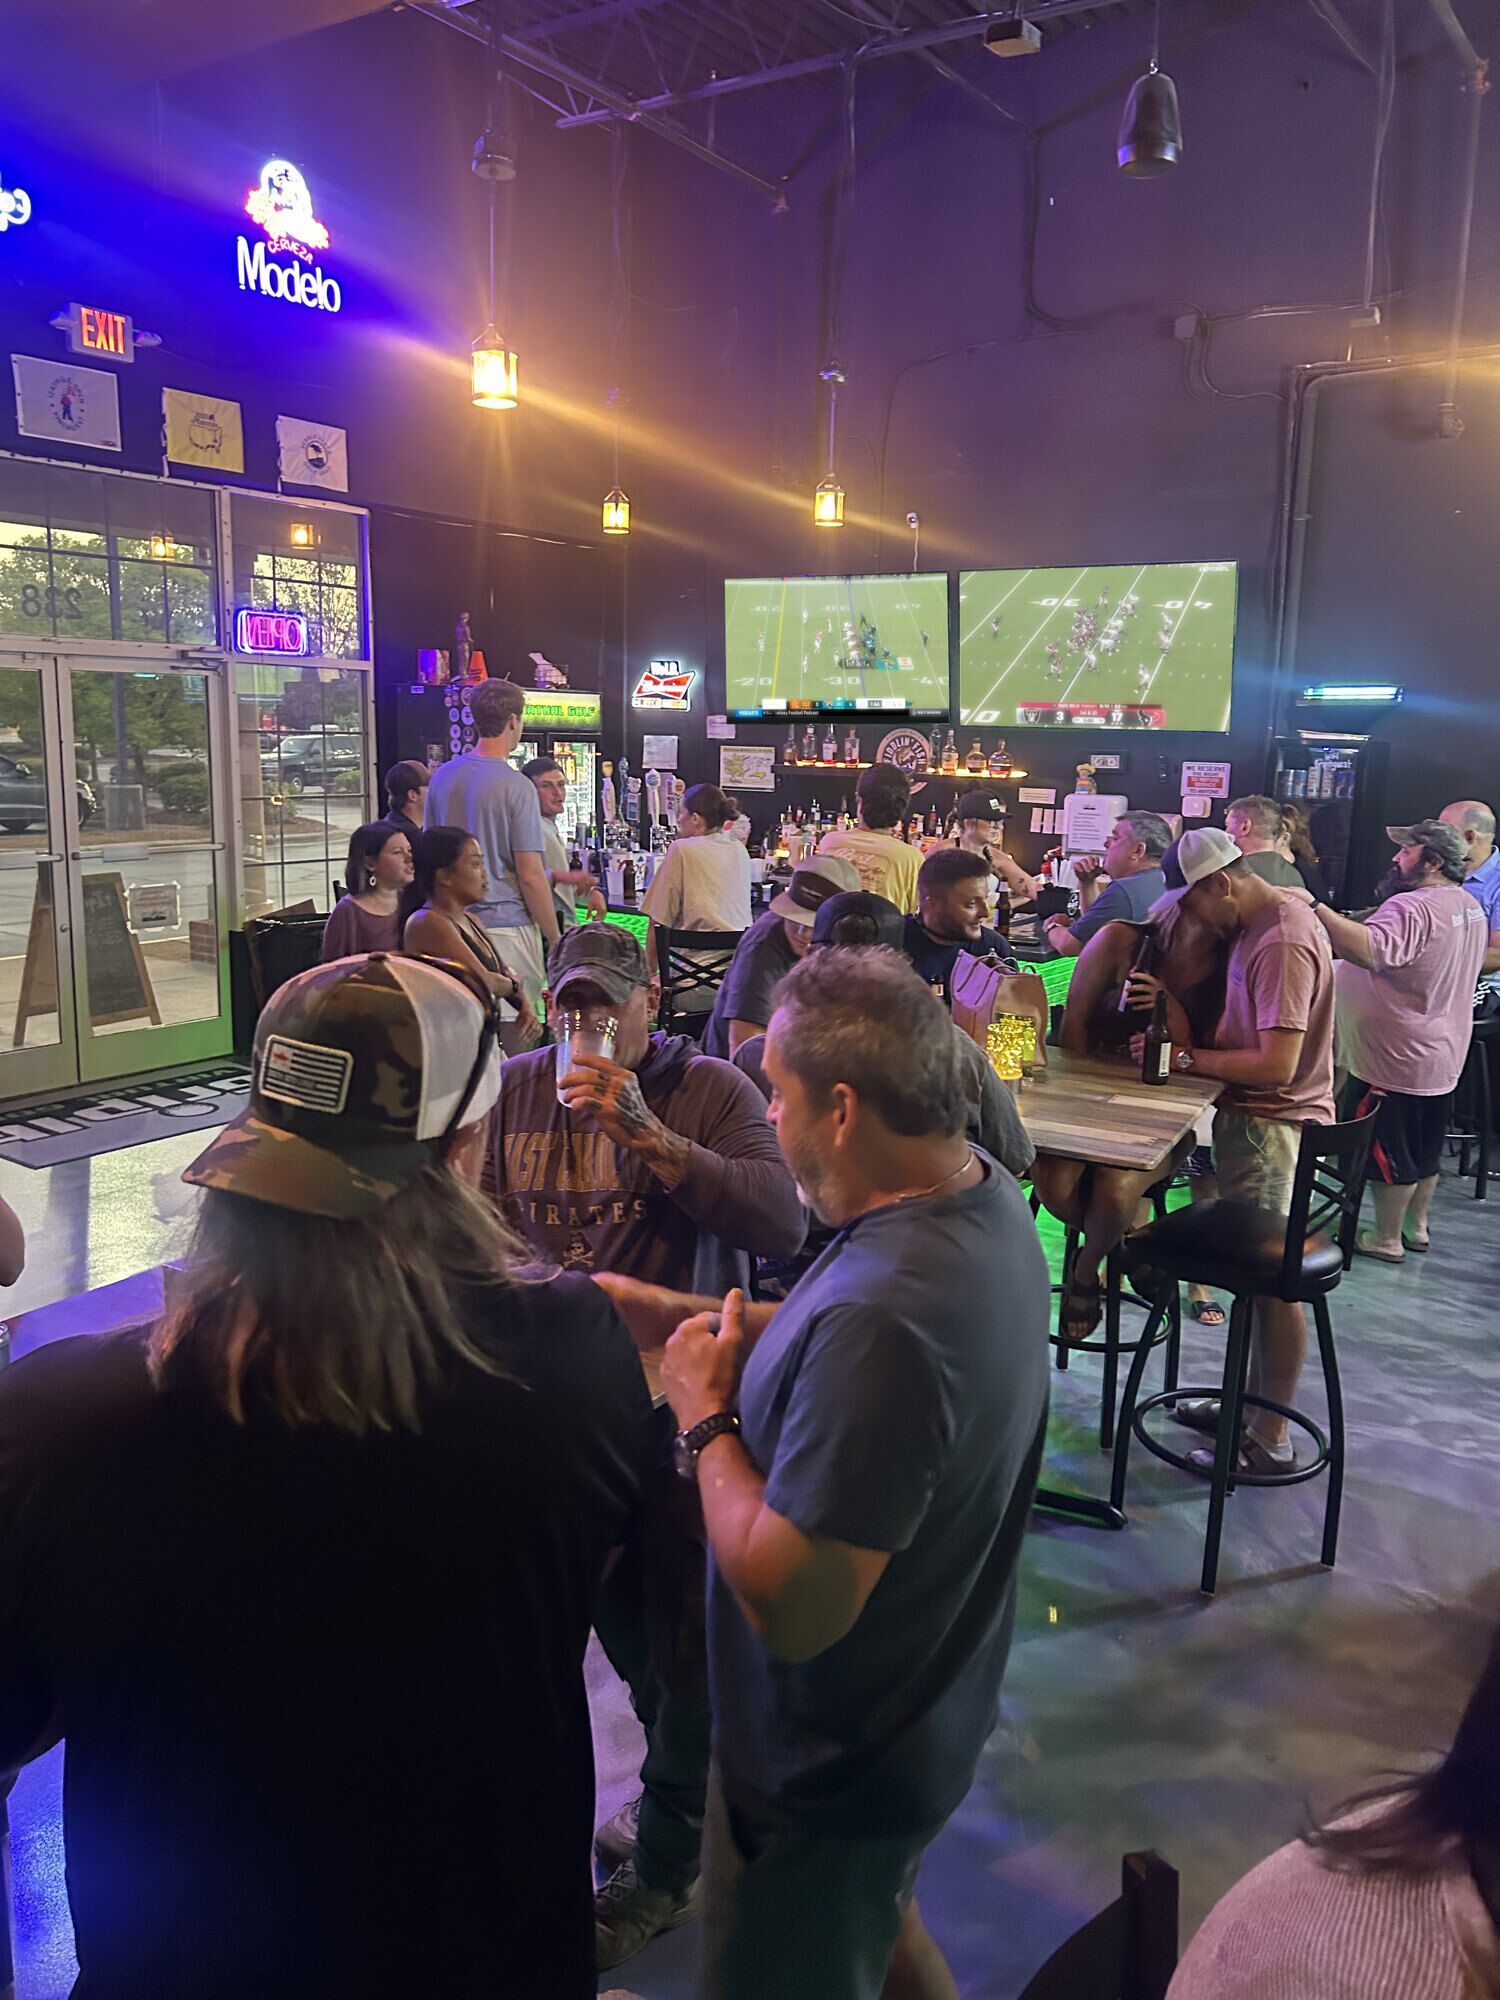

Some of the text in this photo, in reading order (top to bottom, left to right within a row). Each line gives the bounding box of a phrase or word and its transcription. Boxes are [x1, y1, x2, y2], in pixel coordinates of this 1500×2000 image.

[267, 238, 313, 265] CERVEZA
[237, 235, 341, 313] Modelo
[80, 307, 126, 354] EXIT
[741, 677, 773, 686] 20
[829, 676, 861, 685] 30
[525, 705, 596, 717] RTUAL GOLF
[1056, 711, 1065, 721] 3
[1111, 712, 1123, 722] 17
[883, 737, 927, 765] FIDDLIN' FISH
[517, 1199, 646, 1226] IRATES
